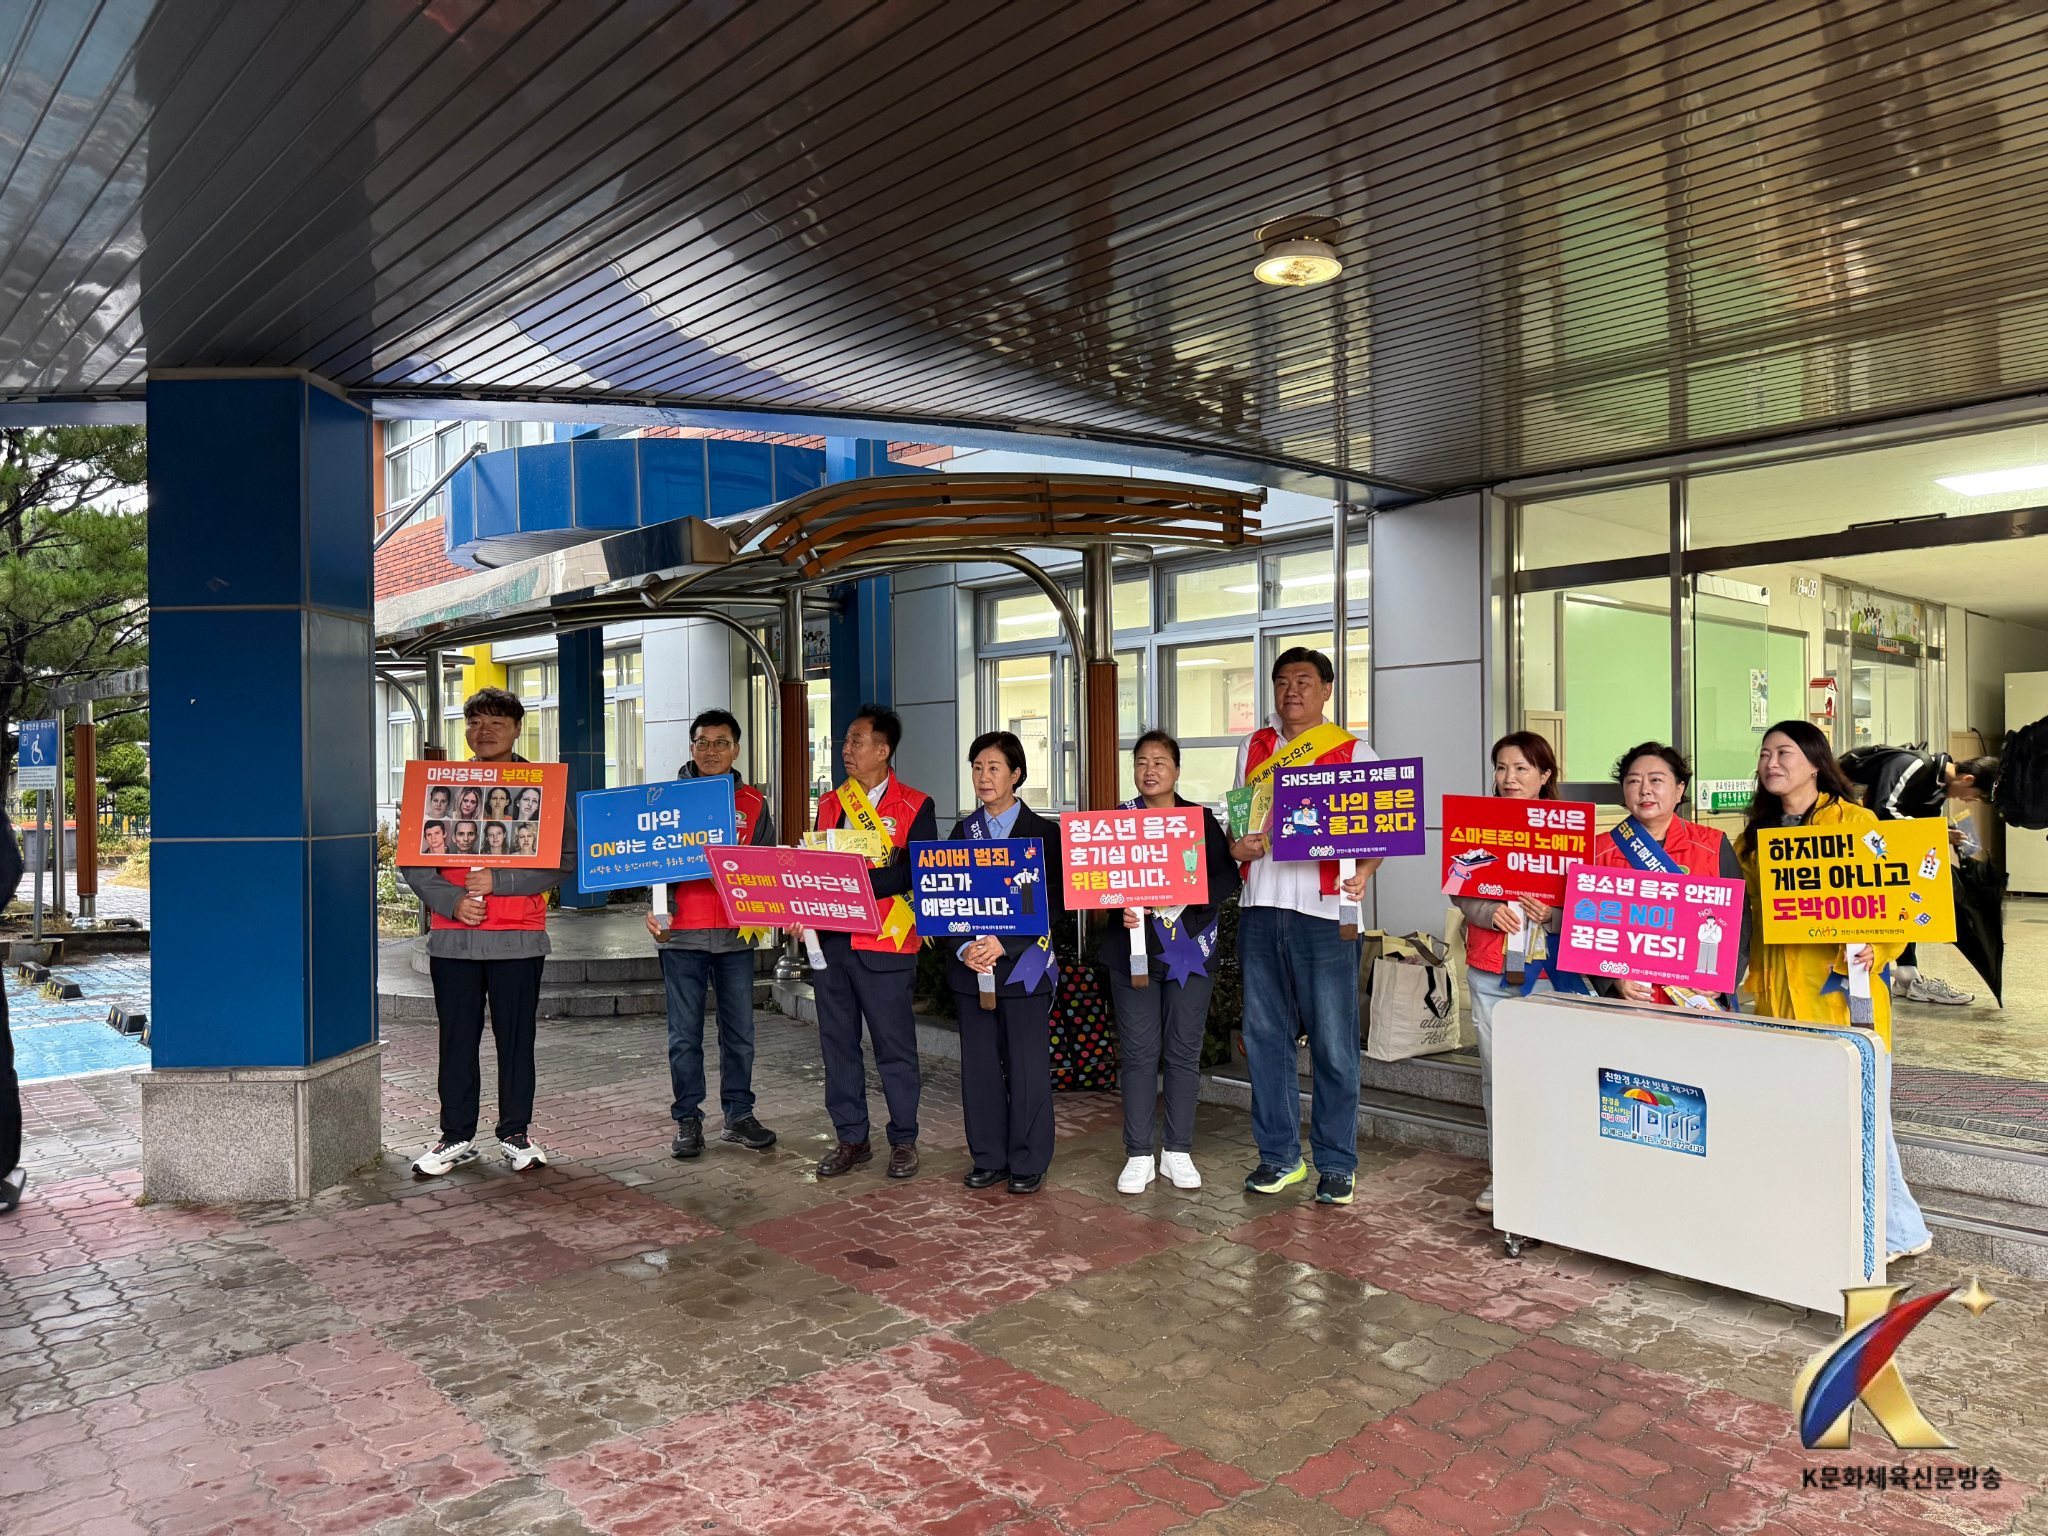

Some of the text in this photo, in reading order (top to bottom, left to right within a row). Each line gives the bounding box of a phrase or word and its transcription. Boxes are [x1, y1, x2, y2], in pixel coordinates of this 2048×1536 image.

[427, 767, 544, 783] 마약중독의 부작용
[1281, 766, 1415, 787] SNS보며 웃고 있을 때
[1329, 788, 1414, 813] 나의 몸은
[637, 808, 680, 831] 마약
[1068, 816, 1196, 843] 청소년 음주,
[1329, 812, 1416, 836] 울고 있다
[1527, 807, 1586, 831] 당신은
[590, 828, 724, 858] ON하는 순간NO답
[1450, 827, 1586, 853] 스마트폰의 노예가
[1769, 834, 1854, 861] 하지마!
[918, 847, 1015, 868] 사이버 범죄,
[1070, 843, 1169, 866] 호기심 아닌
[725, 873, 861, 894] 다함께! 마약근절
[920, 873, 972, 892] 신고가
[1071, 868, 1171, 891] 위험입니다.
[1771, 862, 1910, 891] 게임 아니고
[1577, 873, 1733, 907] 청소년 음주 안돼!
[735, 901, 867, 920] 이롭게! 미래행복
[921, 897, 1014, 917] 예방입니다.
[1574, 898, 1675, 930] 술은 NO!
[1773, 895, 1887, 921] 도박이야!
[1570, 925, 1686, 961] 꿈은 YES!
[1605, 1071, 1698, 1097] 친환경 우산 빗물 제거기
